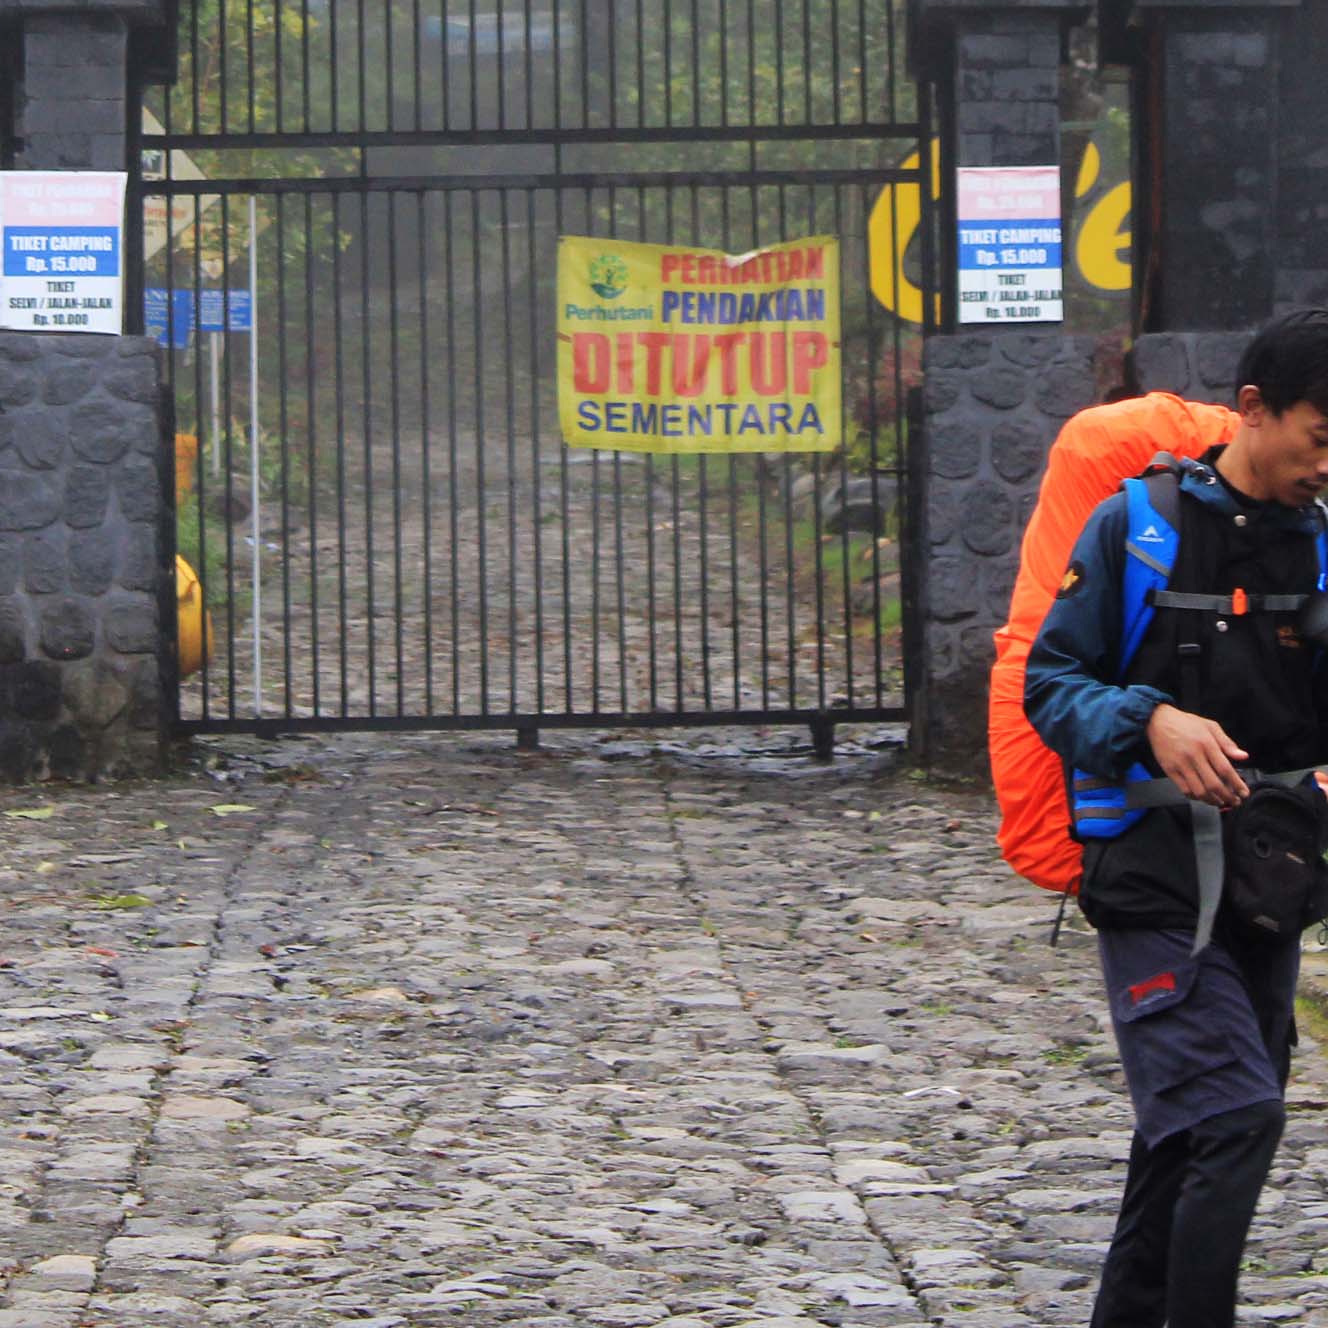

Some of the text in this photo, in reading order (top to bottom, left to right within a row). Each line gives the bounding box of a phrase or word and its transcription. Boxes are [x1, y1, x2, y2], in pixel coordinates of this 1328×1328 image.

[10, 236, 112, 251] TIKET CAMPING
[960, 228, 1062, 244] TIKET CAMPING
[26, 256, 96, 272] Rp. 15.000
[976, 248, 1047, 265] Rp. 15.000
[661, 246, 825, 285] PERHATIAN
[47, 281, 75, 292] TIKET
[998, 274, 1025, 285] TIKET
[565, 304, 653, 321] Perhutani
[662, 289, 825, 325] PENDAKIAN
[986, 308, 1001, 319] Rp.
[33, 314, 49, 326] Rp.
[573, 331, 828, 398] DITUTUP
[577, 400, 824, 436] SEMENTARA
